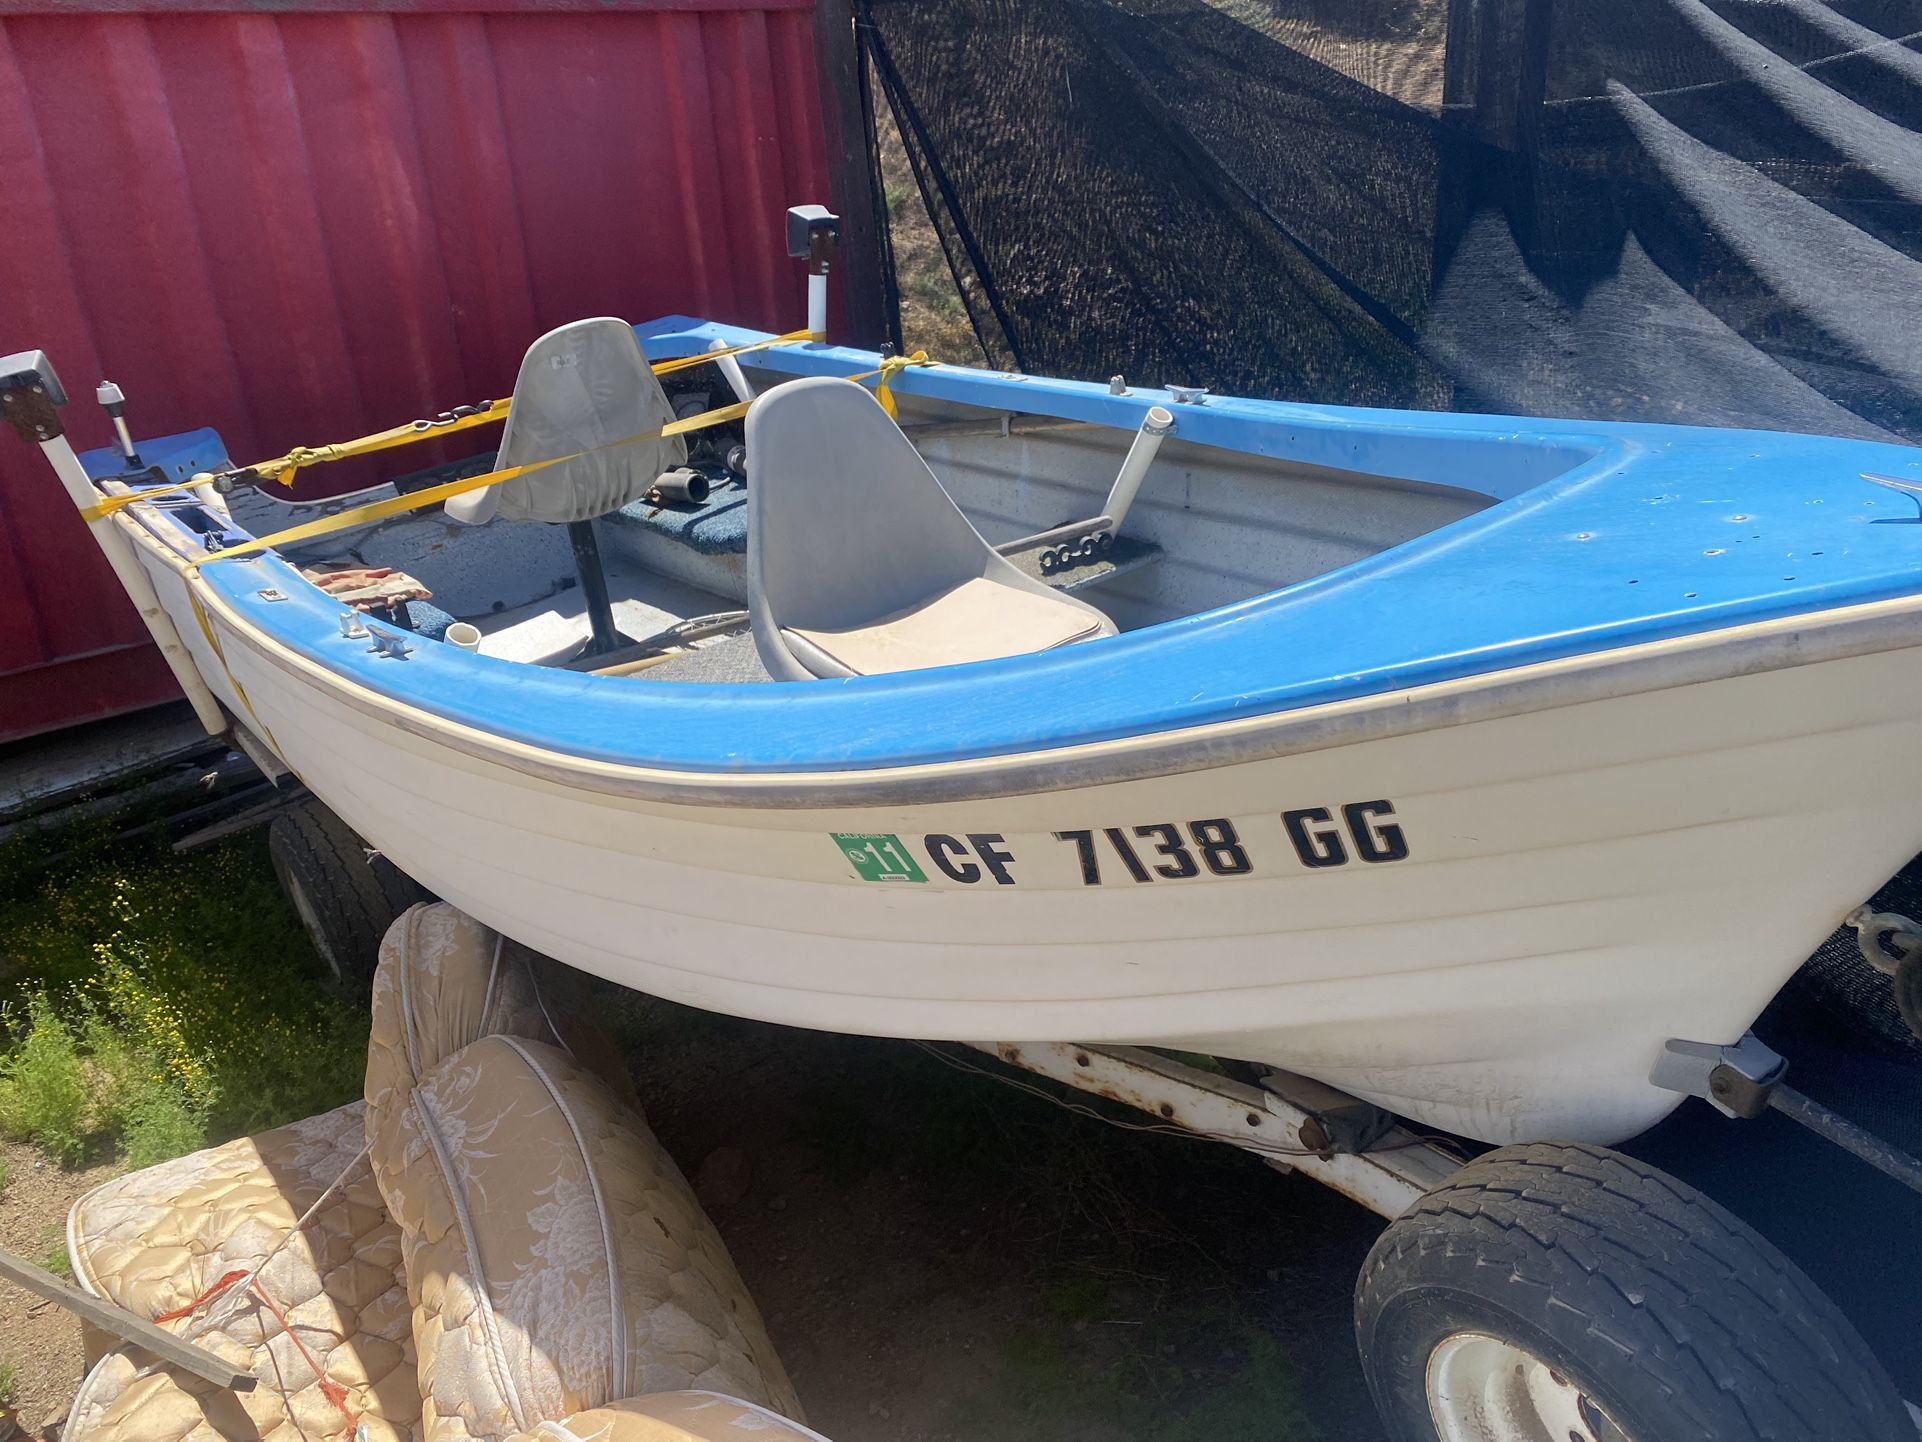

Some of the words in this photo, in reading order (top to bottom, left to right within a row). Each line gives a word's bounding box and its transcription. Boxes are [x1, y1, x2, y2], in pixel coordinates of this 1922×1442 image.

[864, 842, 912, 872] 11
[924, 833, 1016, 885] CF
[1051, 818, 1254, 886] 7138
[1280, 799, 1410, 868] GG
